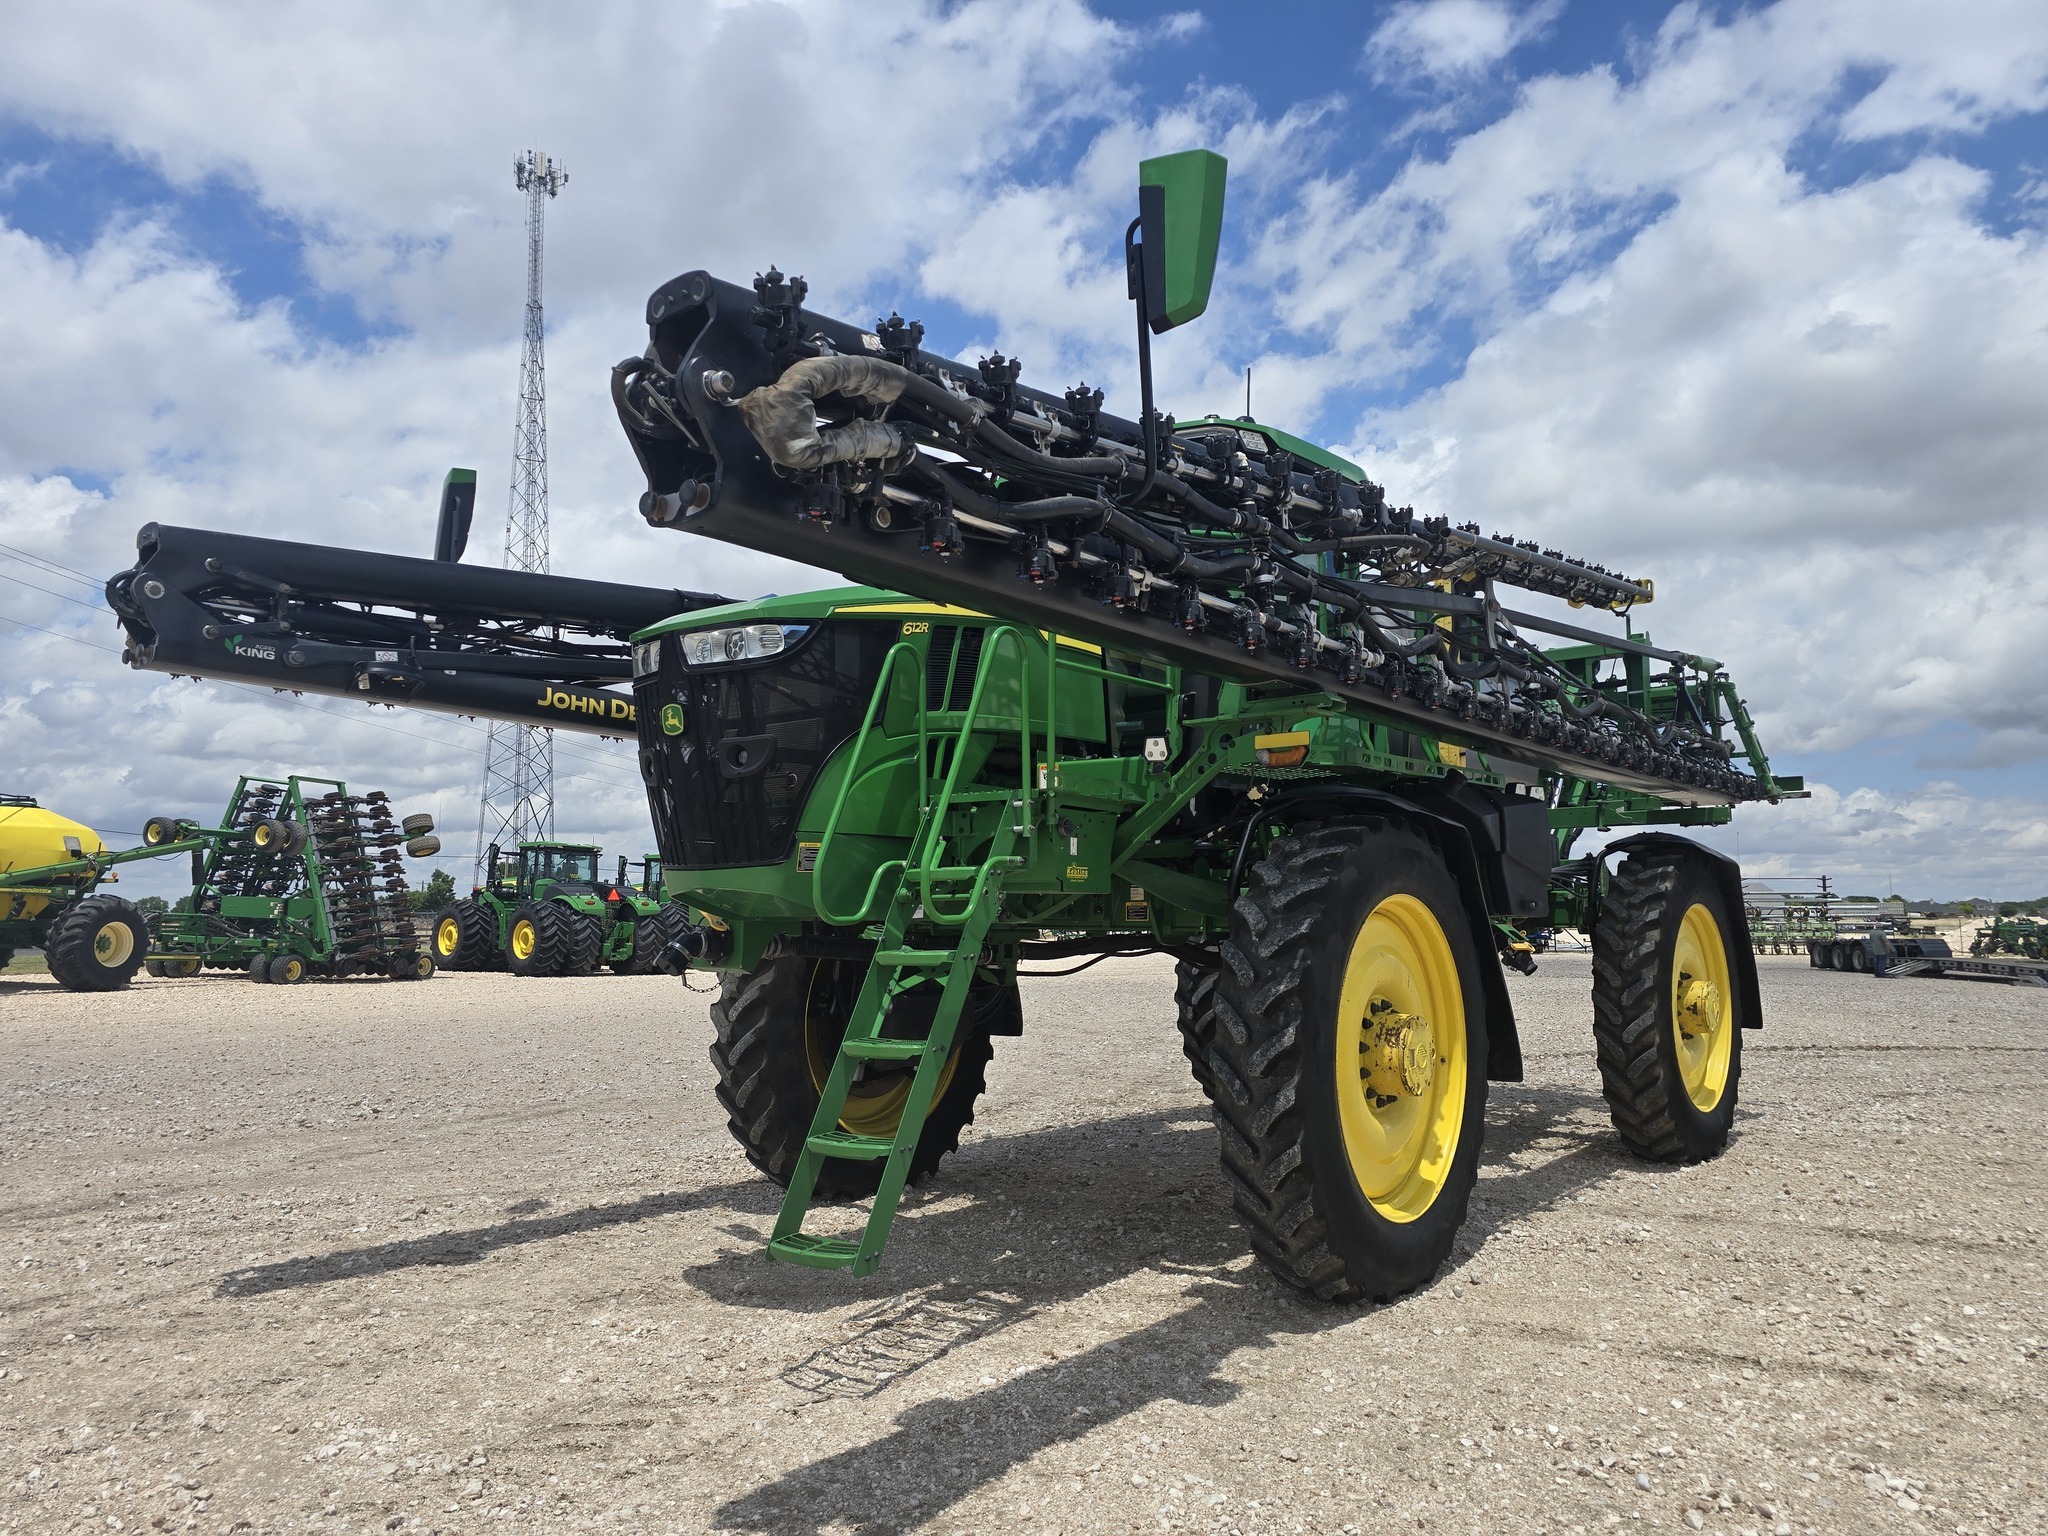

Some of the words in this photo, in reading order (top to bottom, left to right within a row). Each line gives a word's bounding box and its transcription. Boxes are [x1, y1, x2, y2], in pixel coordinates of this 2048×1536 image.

[903, 621, 929, 635] 612R
[235, 645, 276, 660] KING
[255, 644, 276, 652] AGRO
[537, 686, 605, 716] JOHN
